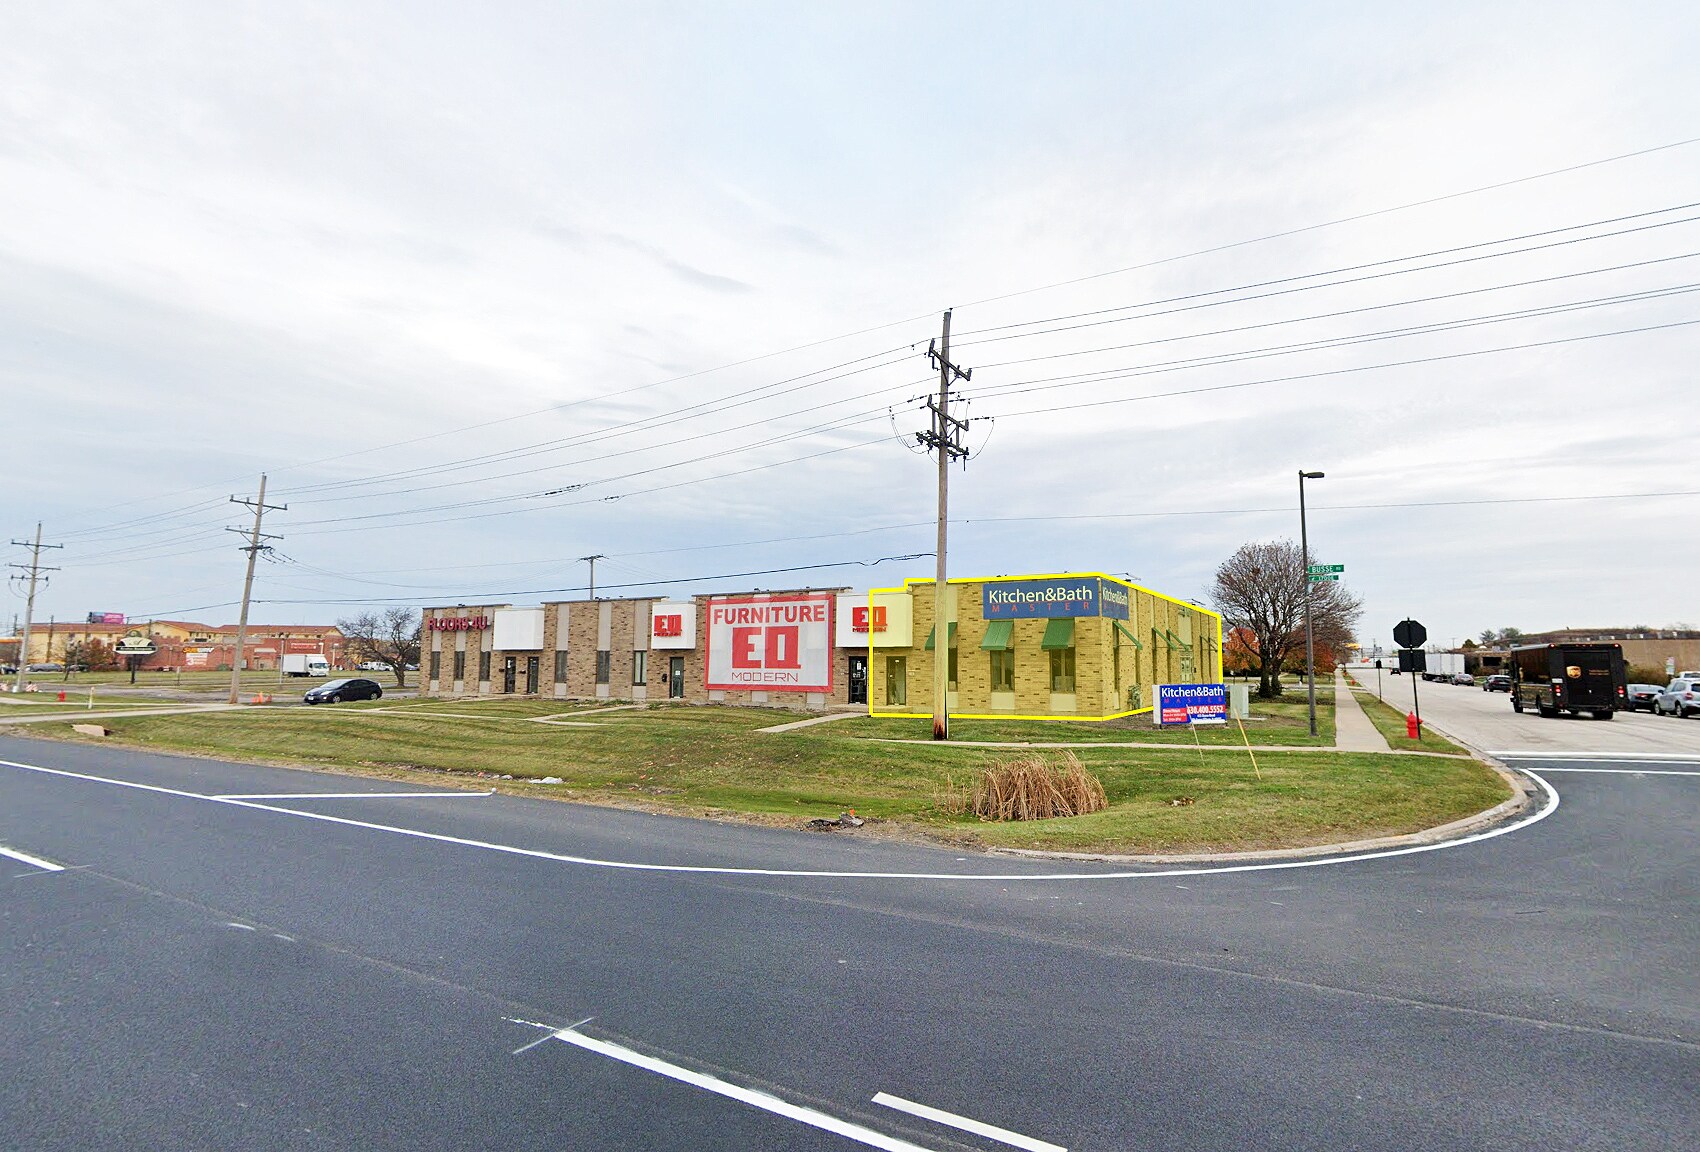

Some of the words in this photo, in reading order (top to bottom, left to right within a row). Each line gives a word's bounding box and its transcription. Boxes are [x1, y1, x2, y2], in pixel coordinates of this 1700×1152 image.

[989, 586, 1093, 604] Kitchen&Bath
[992, 601, 1090, 612] MASTER
[713, 604, 825, 625] FURNITURE
[428, 617, 469, 631] FLOORS
[472, 616, 488, 630] 4U
[731, 672, 799, 682] MODERN
[1161, 686, 1224, 697] Kitchen&Bath
